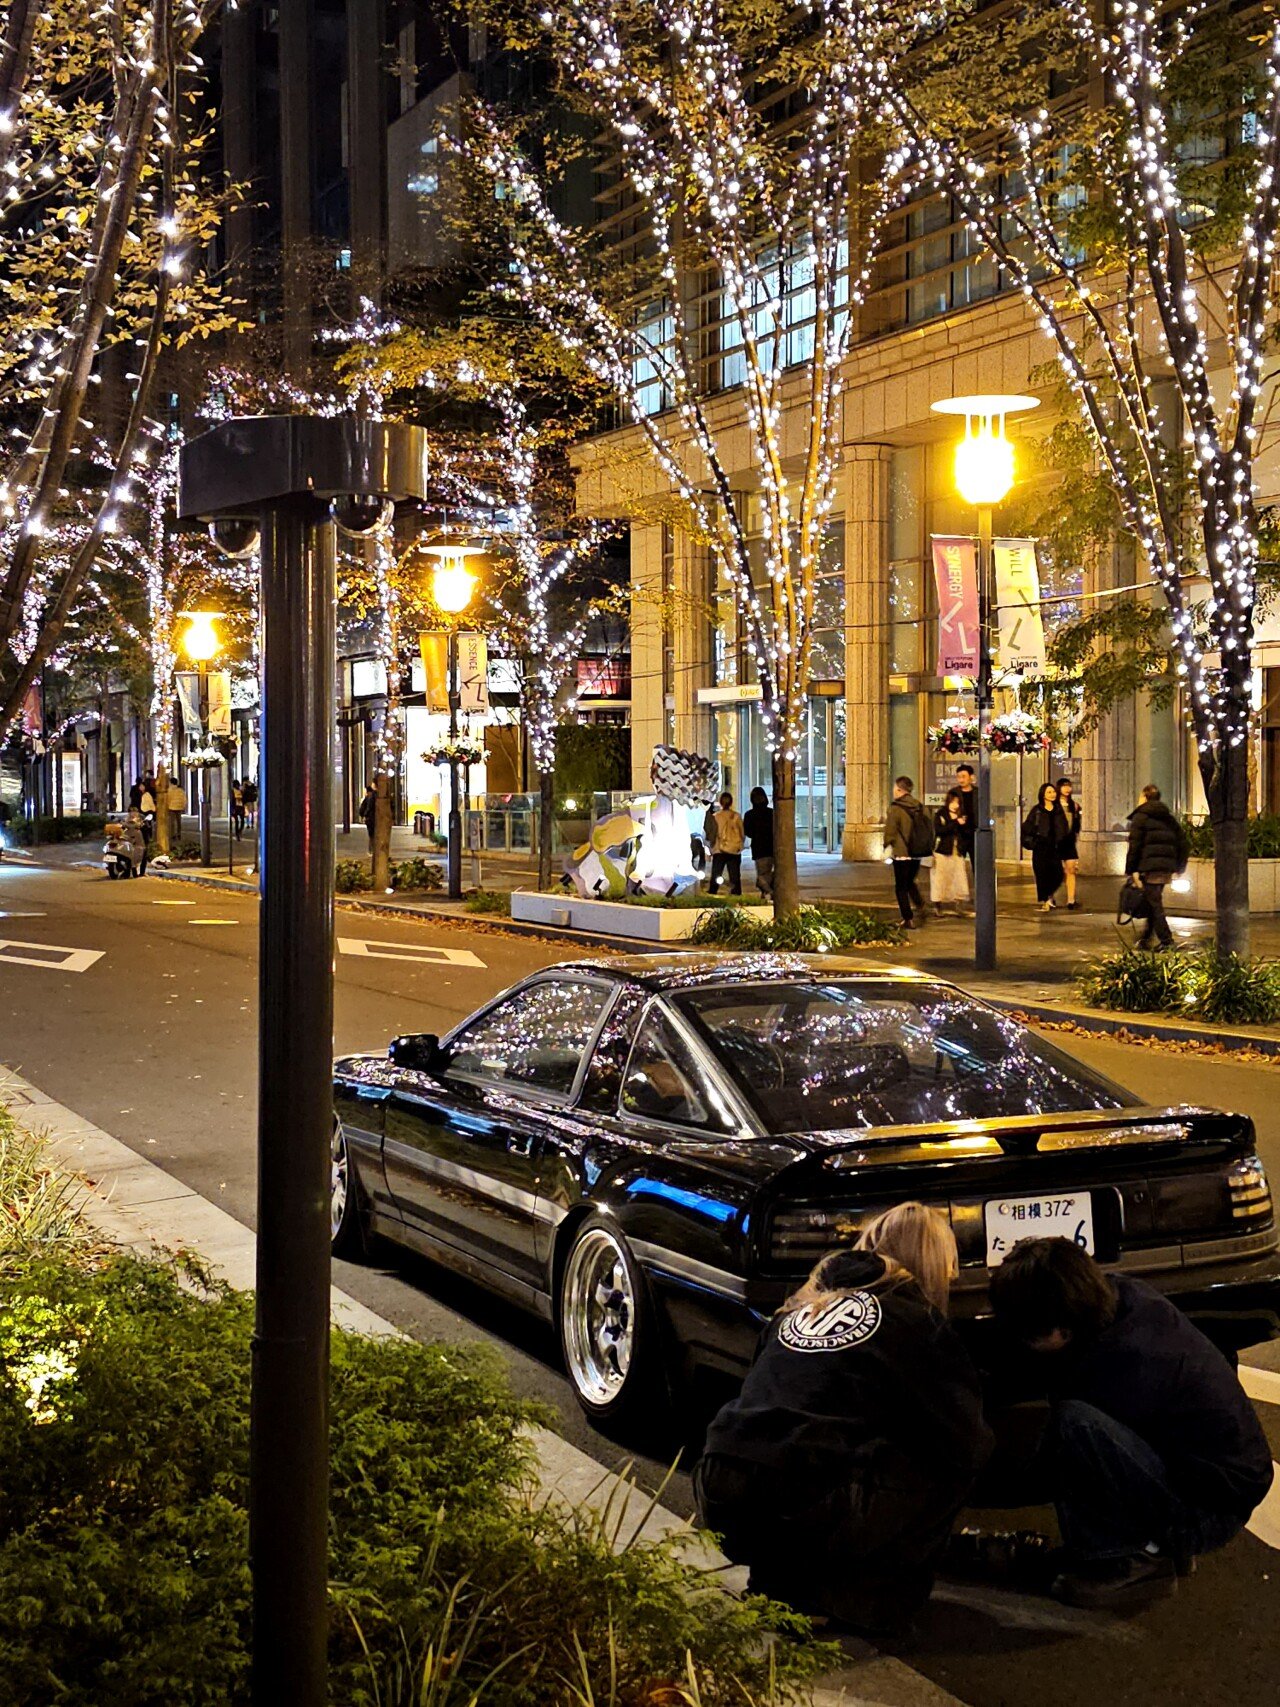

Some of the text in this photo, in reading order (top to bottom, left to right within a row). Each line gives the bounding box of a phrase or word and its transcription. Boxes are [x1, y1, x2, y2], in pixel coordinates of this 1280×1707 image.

[946, 545, 964, 600] SYNERGY
[1009, 547, 1023, 576] WILL
[468, 638, 477, 671] ESSENCE
[944, 660, 974, 670] Ligare
[1012, 1199, 1071, 1220] 相模 372
[992, 1219, 1088, 1251] た 6
[799, 1324, 870, 1348] FRANCISCO
